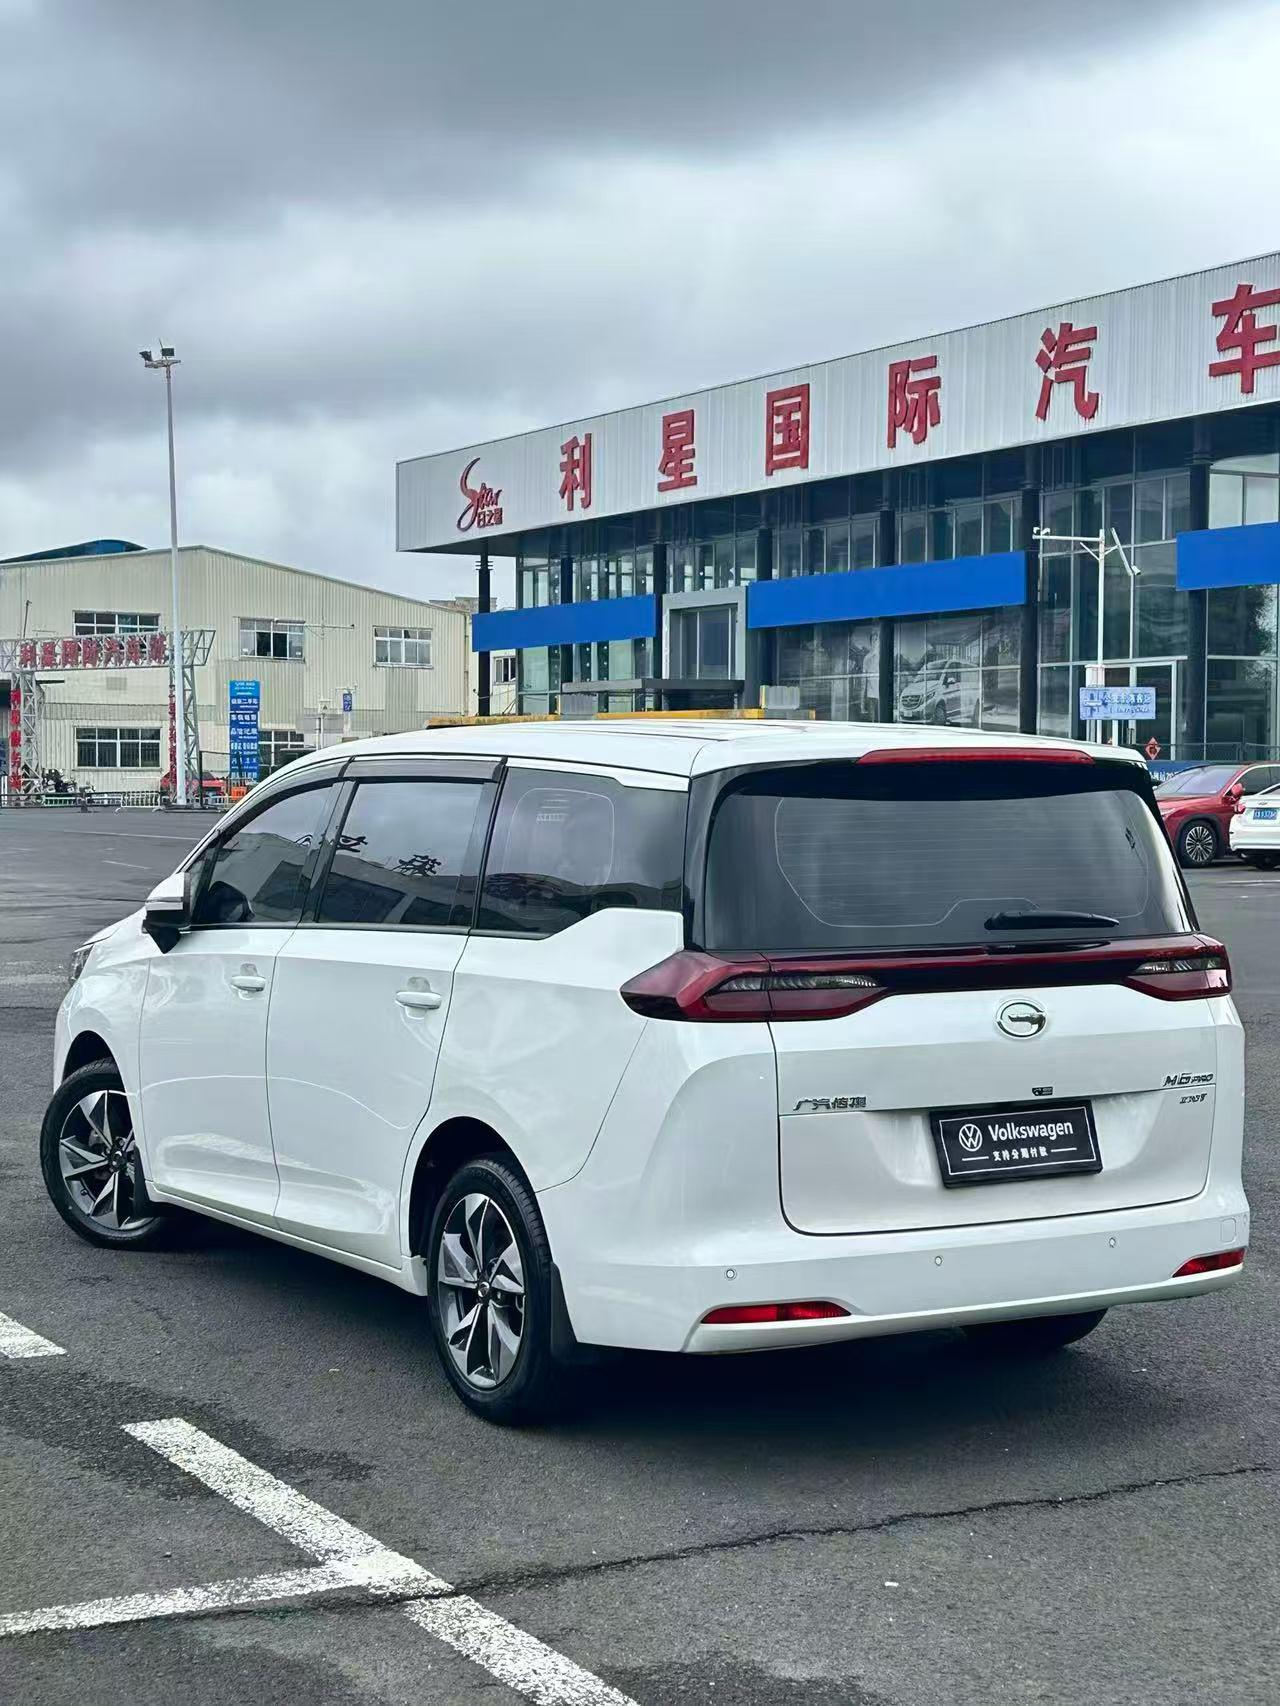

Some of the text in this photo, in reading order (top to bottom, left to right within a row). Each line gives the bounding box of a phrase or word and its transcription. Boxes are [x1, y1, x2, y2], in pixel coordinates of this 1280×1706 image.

[558, 284, 1280, 512] 利星国际汽车
[988, 1121, 1074, 1142] Volkswagen
